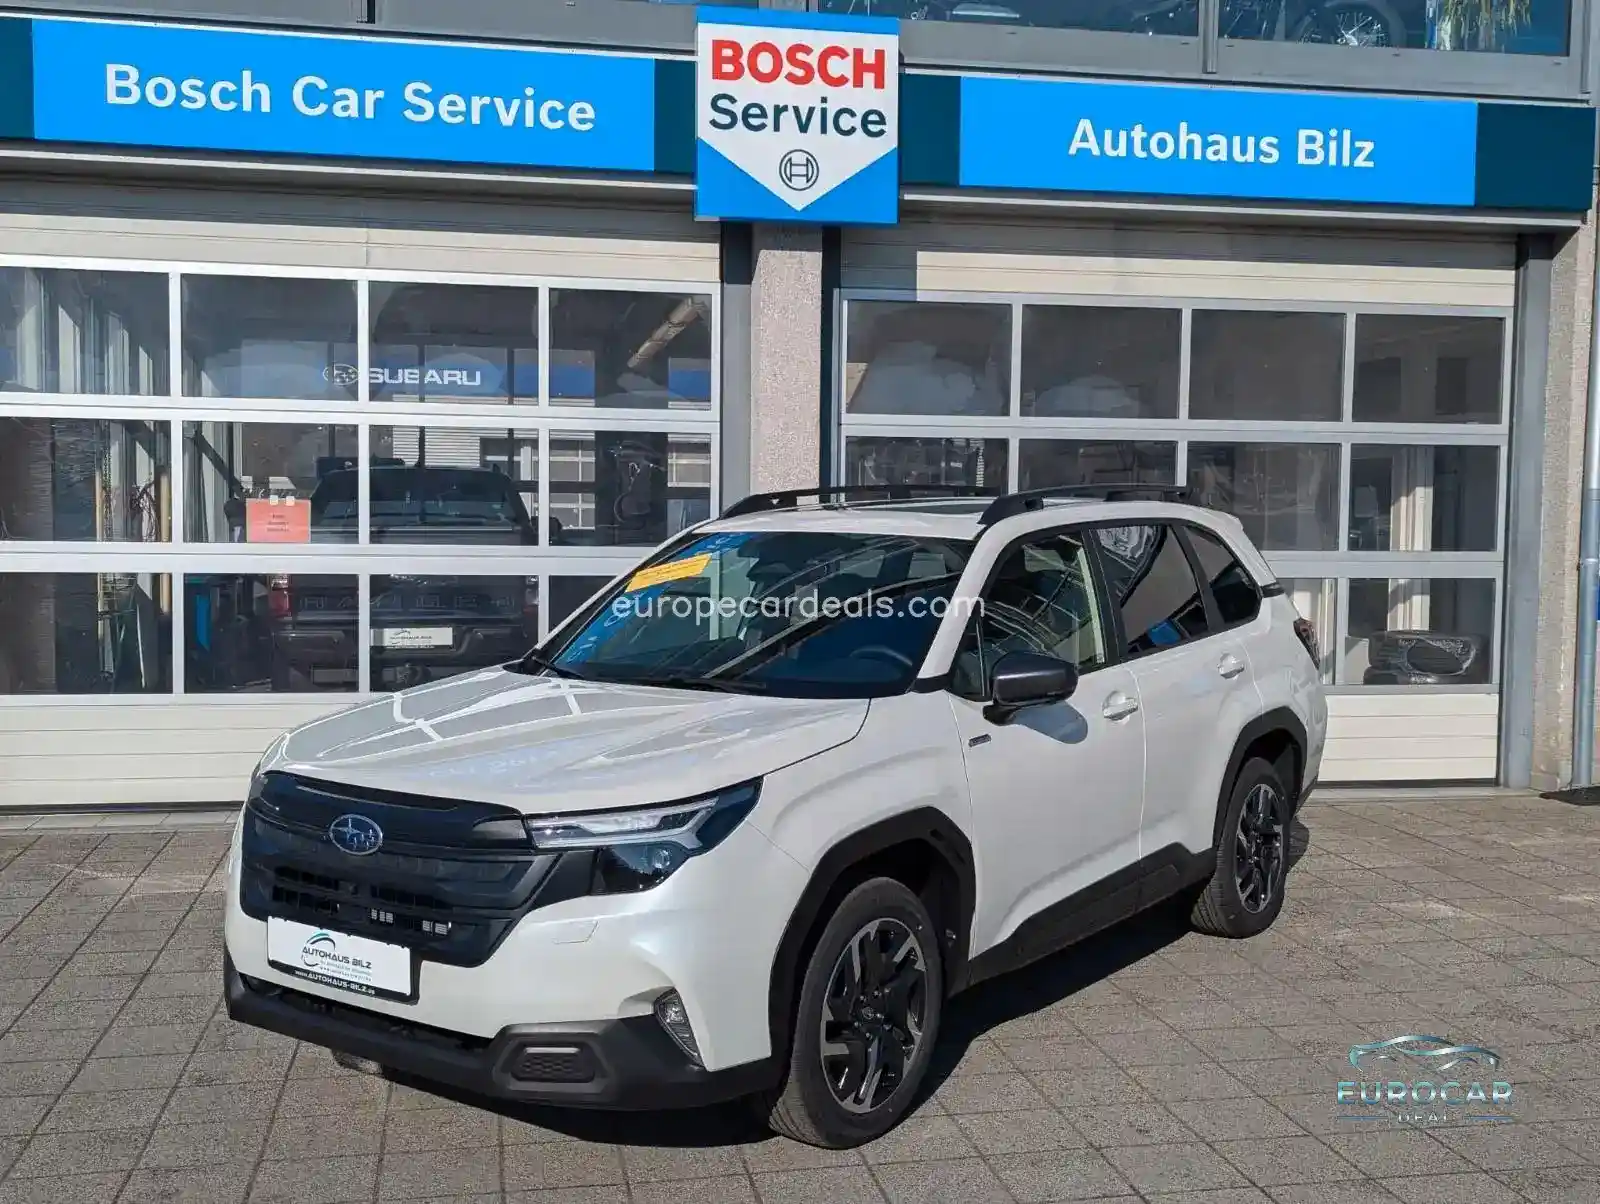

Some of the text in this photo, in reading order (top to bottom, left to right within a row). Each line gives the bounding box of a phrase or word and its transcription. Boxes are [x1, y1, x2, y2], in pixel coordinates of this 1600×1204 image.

[711, 39, 886, 90] BOSCH
[105, 63, 596, 131] Bosch Car Service
[709, 93, 887, 138] Service
[1068, 118, 1376, 168] Autohaus Bilz
[369, 367, 481, 386] SUBARU
[302, 945, 373, 969] AUTOHAUS BILZ
